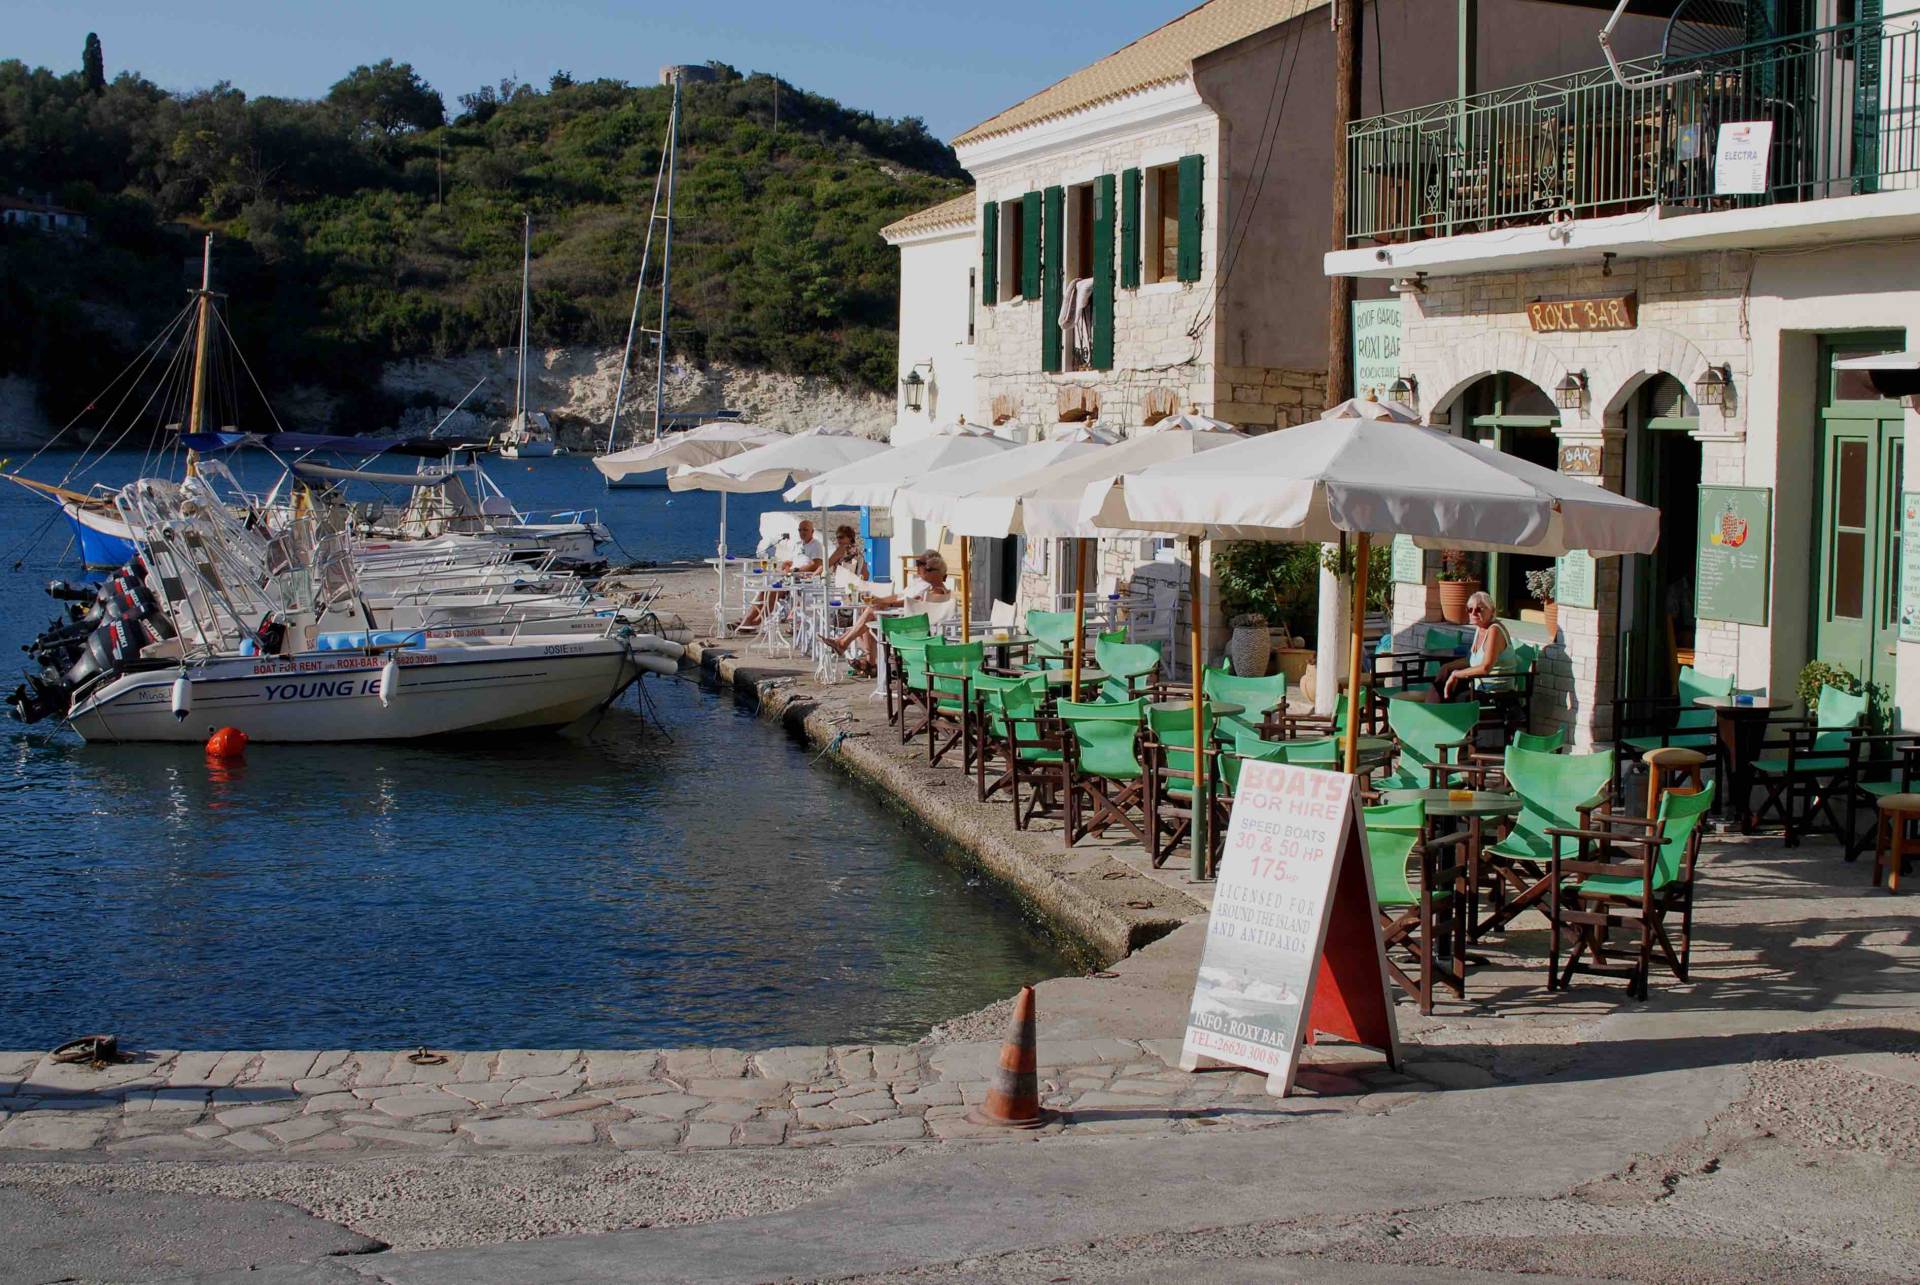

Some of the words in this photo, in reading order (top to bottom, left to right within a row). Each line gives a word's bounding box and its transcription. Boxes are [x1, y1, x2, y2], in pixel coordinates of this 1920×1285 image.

[1724, 151, 1758, 161] ELECTRA
[1357, 309, 1375, 330] ROOF
[1376, 306, 1401, 328] GARDE
[1532, 304, 1580, 330] ROXI
[1583, 300, 1625, 328] BAR
[1358, 335, 1380, 359] ROXI
[1565, 448, 1592, 465] BAR
[115, 620, 129, 648] SUZUKI
[143, 617, 164, 641] SUZUK
[253, 664, 277, 674] BOAT
[279, 662, 297, 673] FOR
[299, 660, 322, 671] RENT
[337, 656, 378, 669] ROXI-BAR
[265, 680, 355, 702] YOUNG
[1244, 764, 1345, 802] BOATS
[1240, 791, 1283, 812] FOR
[1288, 799, 1340, 821] HIRE
[1240, 817, 1281, 836] SPEED
[1284, 825, 1327, 844] BOATS
[1235, 832, 1257, 850] 30
[1278, 839, 1300, 858] 50
[1302, 847, 1325, 862] HP
[1219, 883, 1283, 909] LICENSED
[1288, 897, 1316, 918] FOR
[1217, 903, 1256, 923] AROUND
[1255, 910, 1277, 928] THE
[1274, 913, 1312, 936] ISLAND
[1211, 922, 1236, 938] AND
[1239, 927, 1307, 954] ANTIPAXOS
[1193, 1011, 1223, 1030] INFO
[1229, 1020, 1262, 1041] ROXY
[1260, 1027, 1285, 1048] BAR
